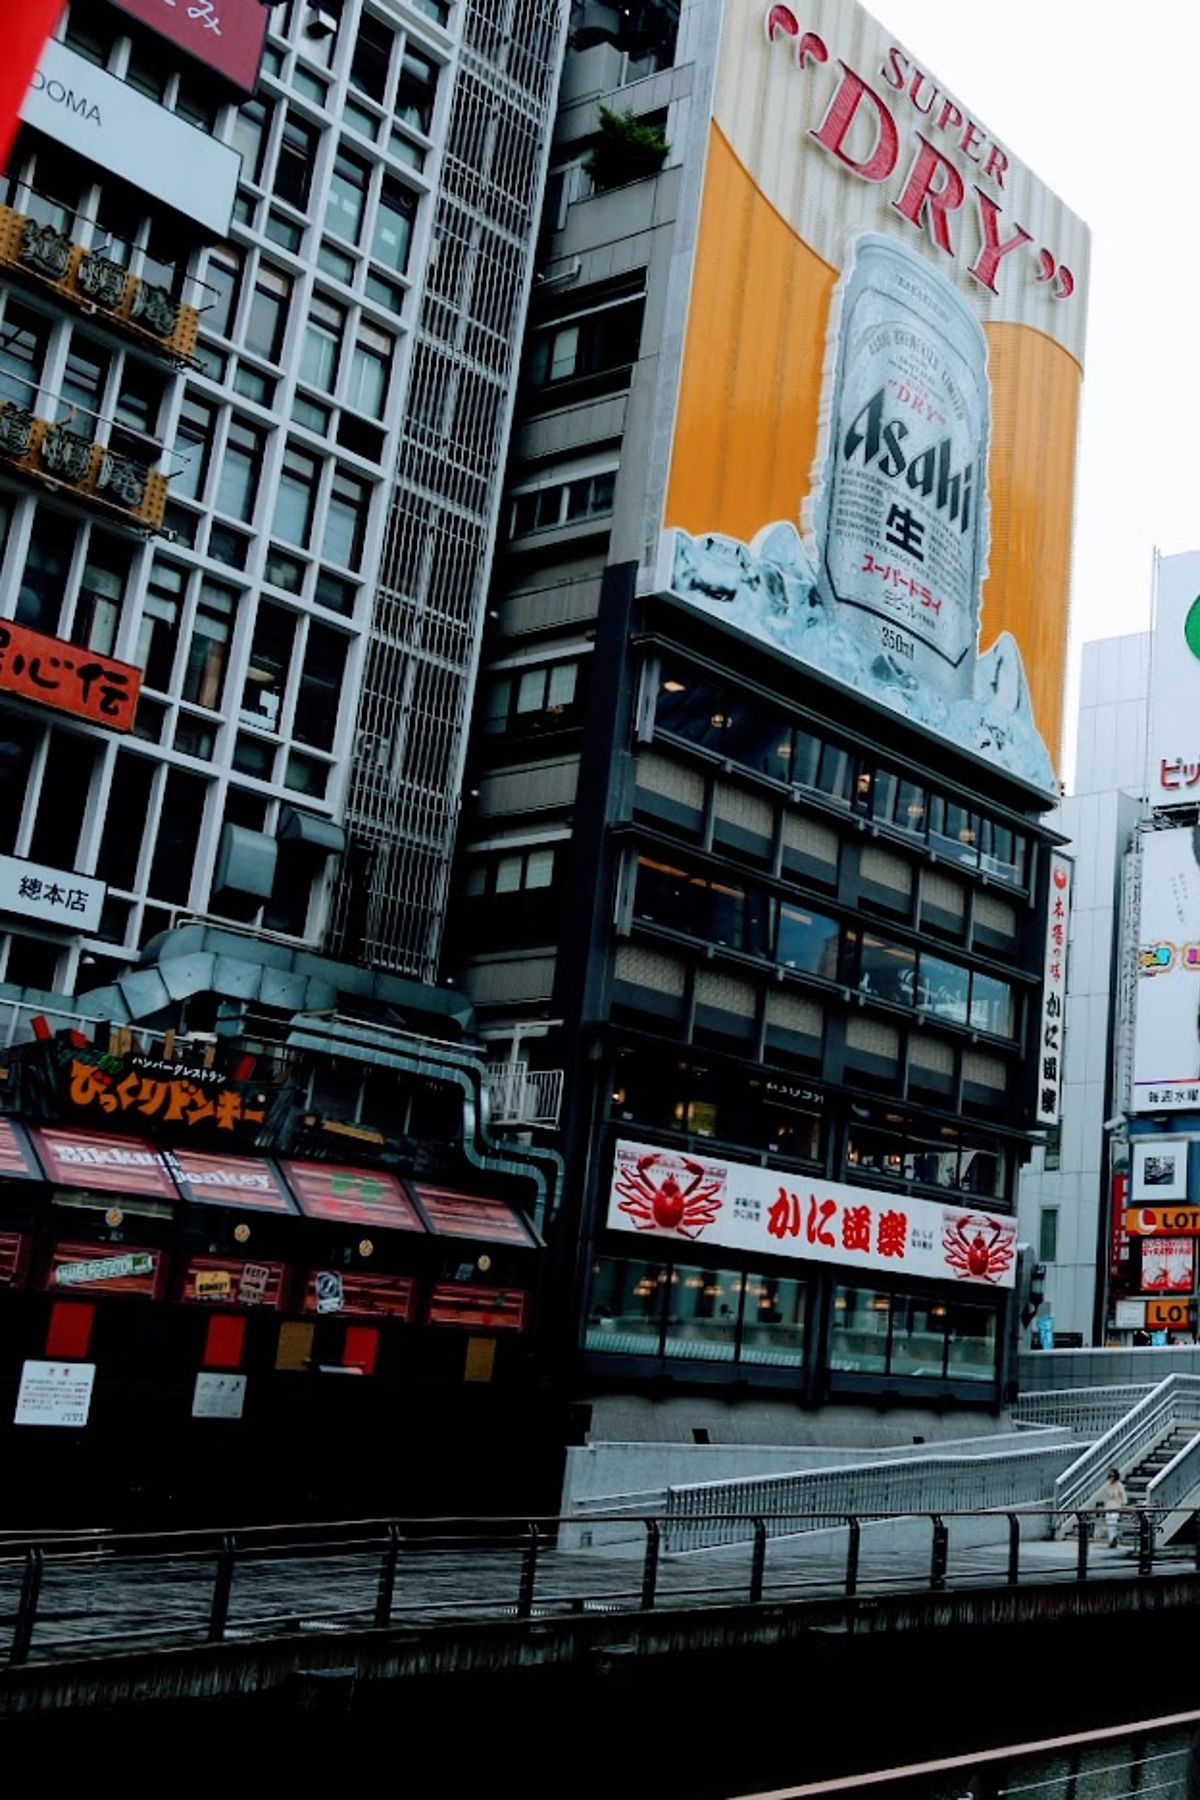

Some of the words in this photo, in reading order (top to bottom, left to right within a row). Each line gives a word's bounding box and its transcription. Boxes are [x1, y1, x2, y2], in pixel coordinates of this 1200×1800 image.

[881, 47, 1009, 190] SUPER
[844, 388, 974, 534] Asahi
[886, 503, 924, 562] 生
[862, 552, 942, 616] スーパードライ
[0, 628, 131, 717] 心伝
[70, 1059, 266, 1131] びっくりドンキー
[132, 1057, 227, 1083] ハンバーグレストラン
[767, 1187, 907, 1258] かに道楽
